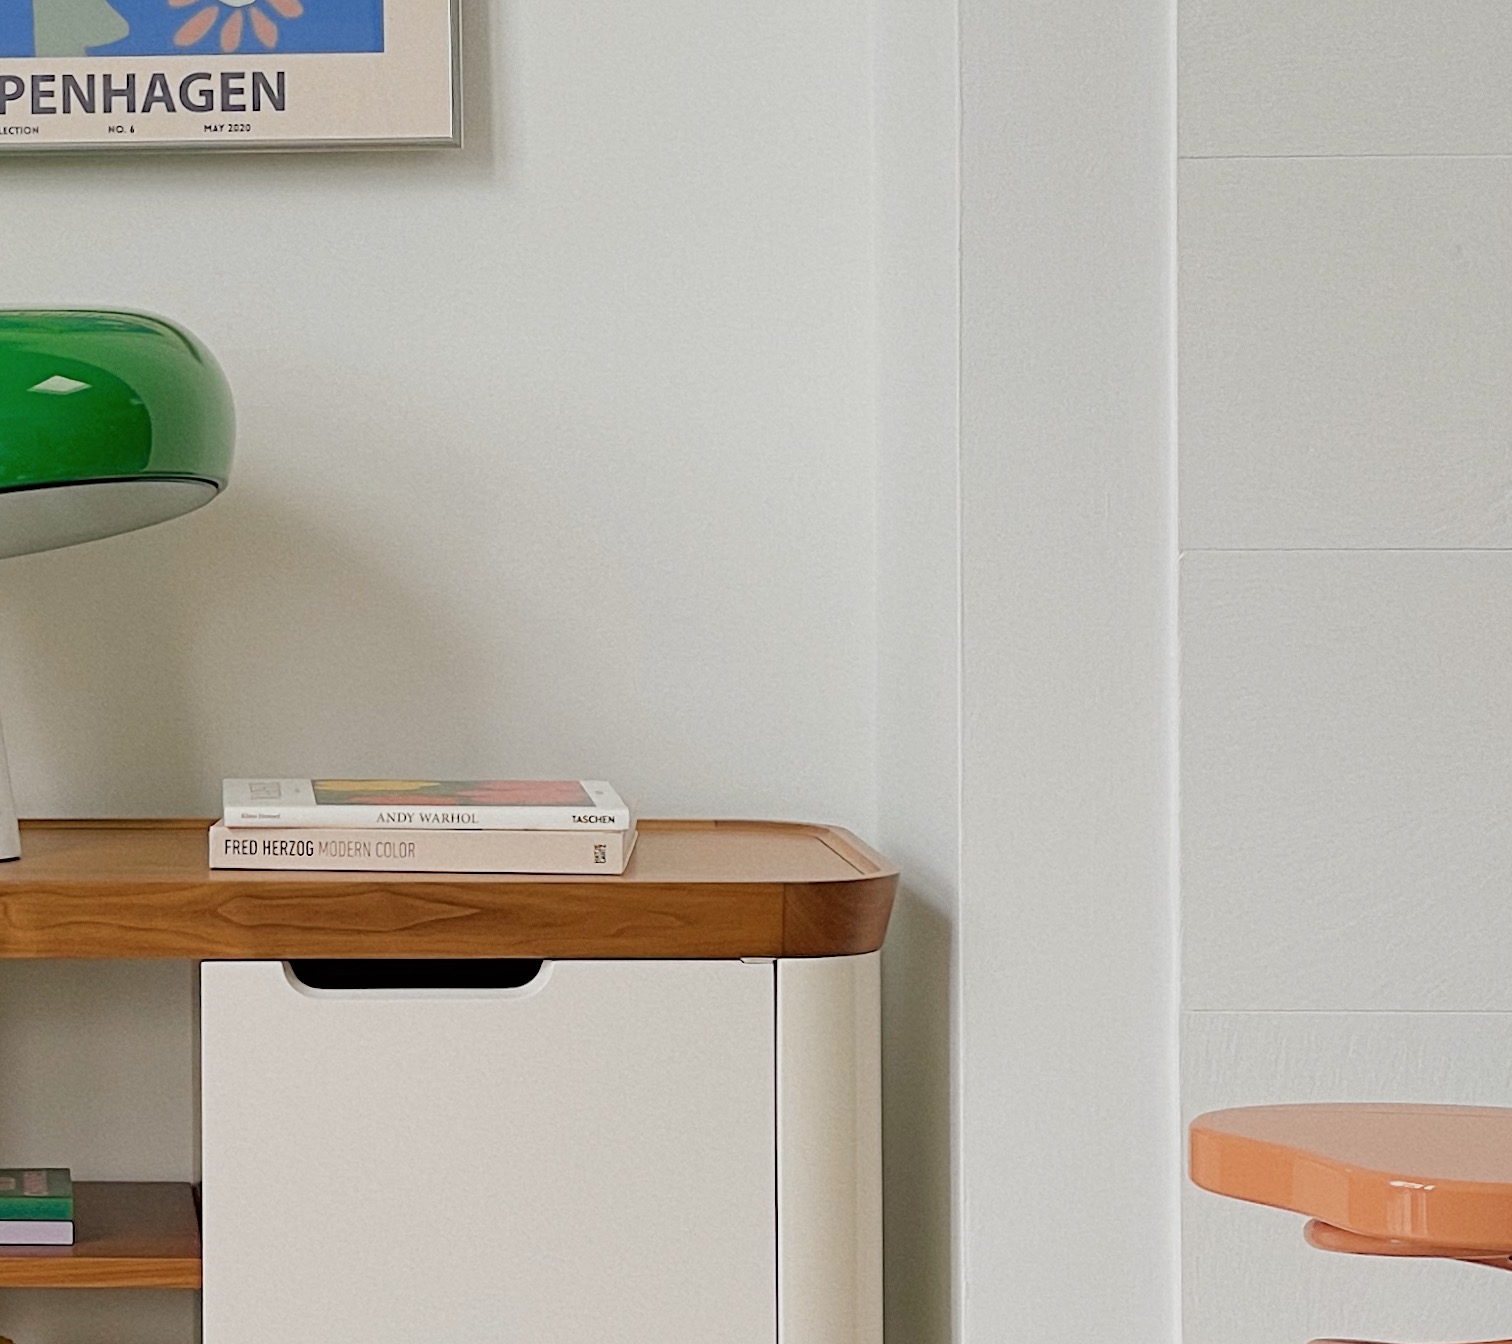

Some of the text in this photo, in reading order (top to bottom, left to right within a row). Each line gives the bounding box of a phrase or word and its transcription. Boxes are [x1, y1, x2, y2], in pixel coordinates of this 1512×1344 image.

[108, 125, 135, 134] NO. 6
[203, 123, 251, 133] MAY 2020
[376, 812, 479, 824] ANDY WARHOL
[572, 814, 615, 824] TASCHEN
[224, 839, 415, 858] FRED HERZOG MODERN COLOR
